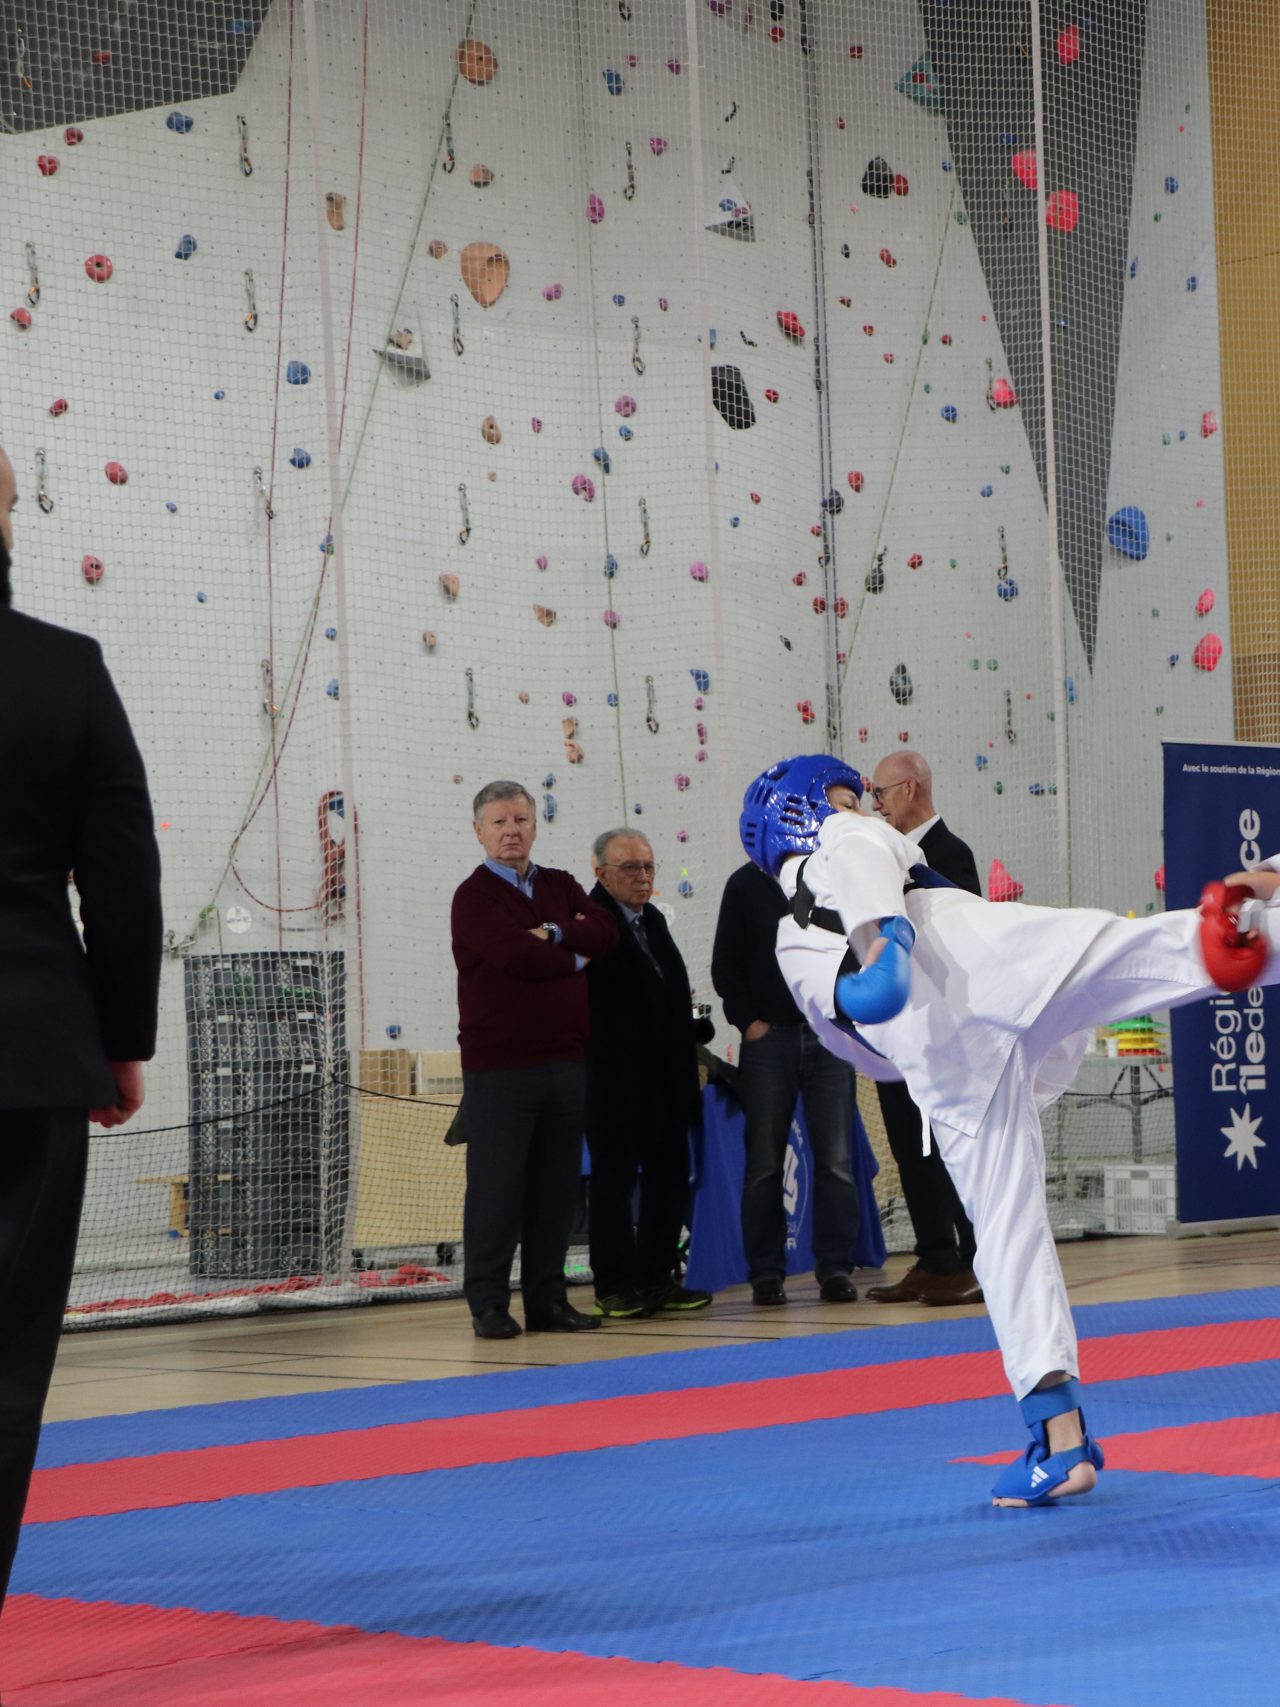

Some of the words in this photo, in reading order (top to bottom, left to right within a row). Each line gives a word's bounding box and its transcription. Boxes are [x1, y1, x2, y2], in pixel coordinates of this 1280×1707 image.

[1182, 763, 1201, 773] Avec
[1201, 764, 1209, 773] le
[1210, 765, 1237, 774] soutien
[1237, 765, 1247, 775] de
[1247, 766, 1255, 775] la
[1208, 990, 1243, 1092] Régi
